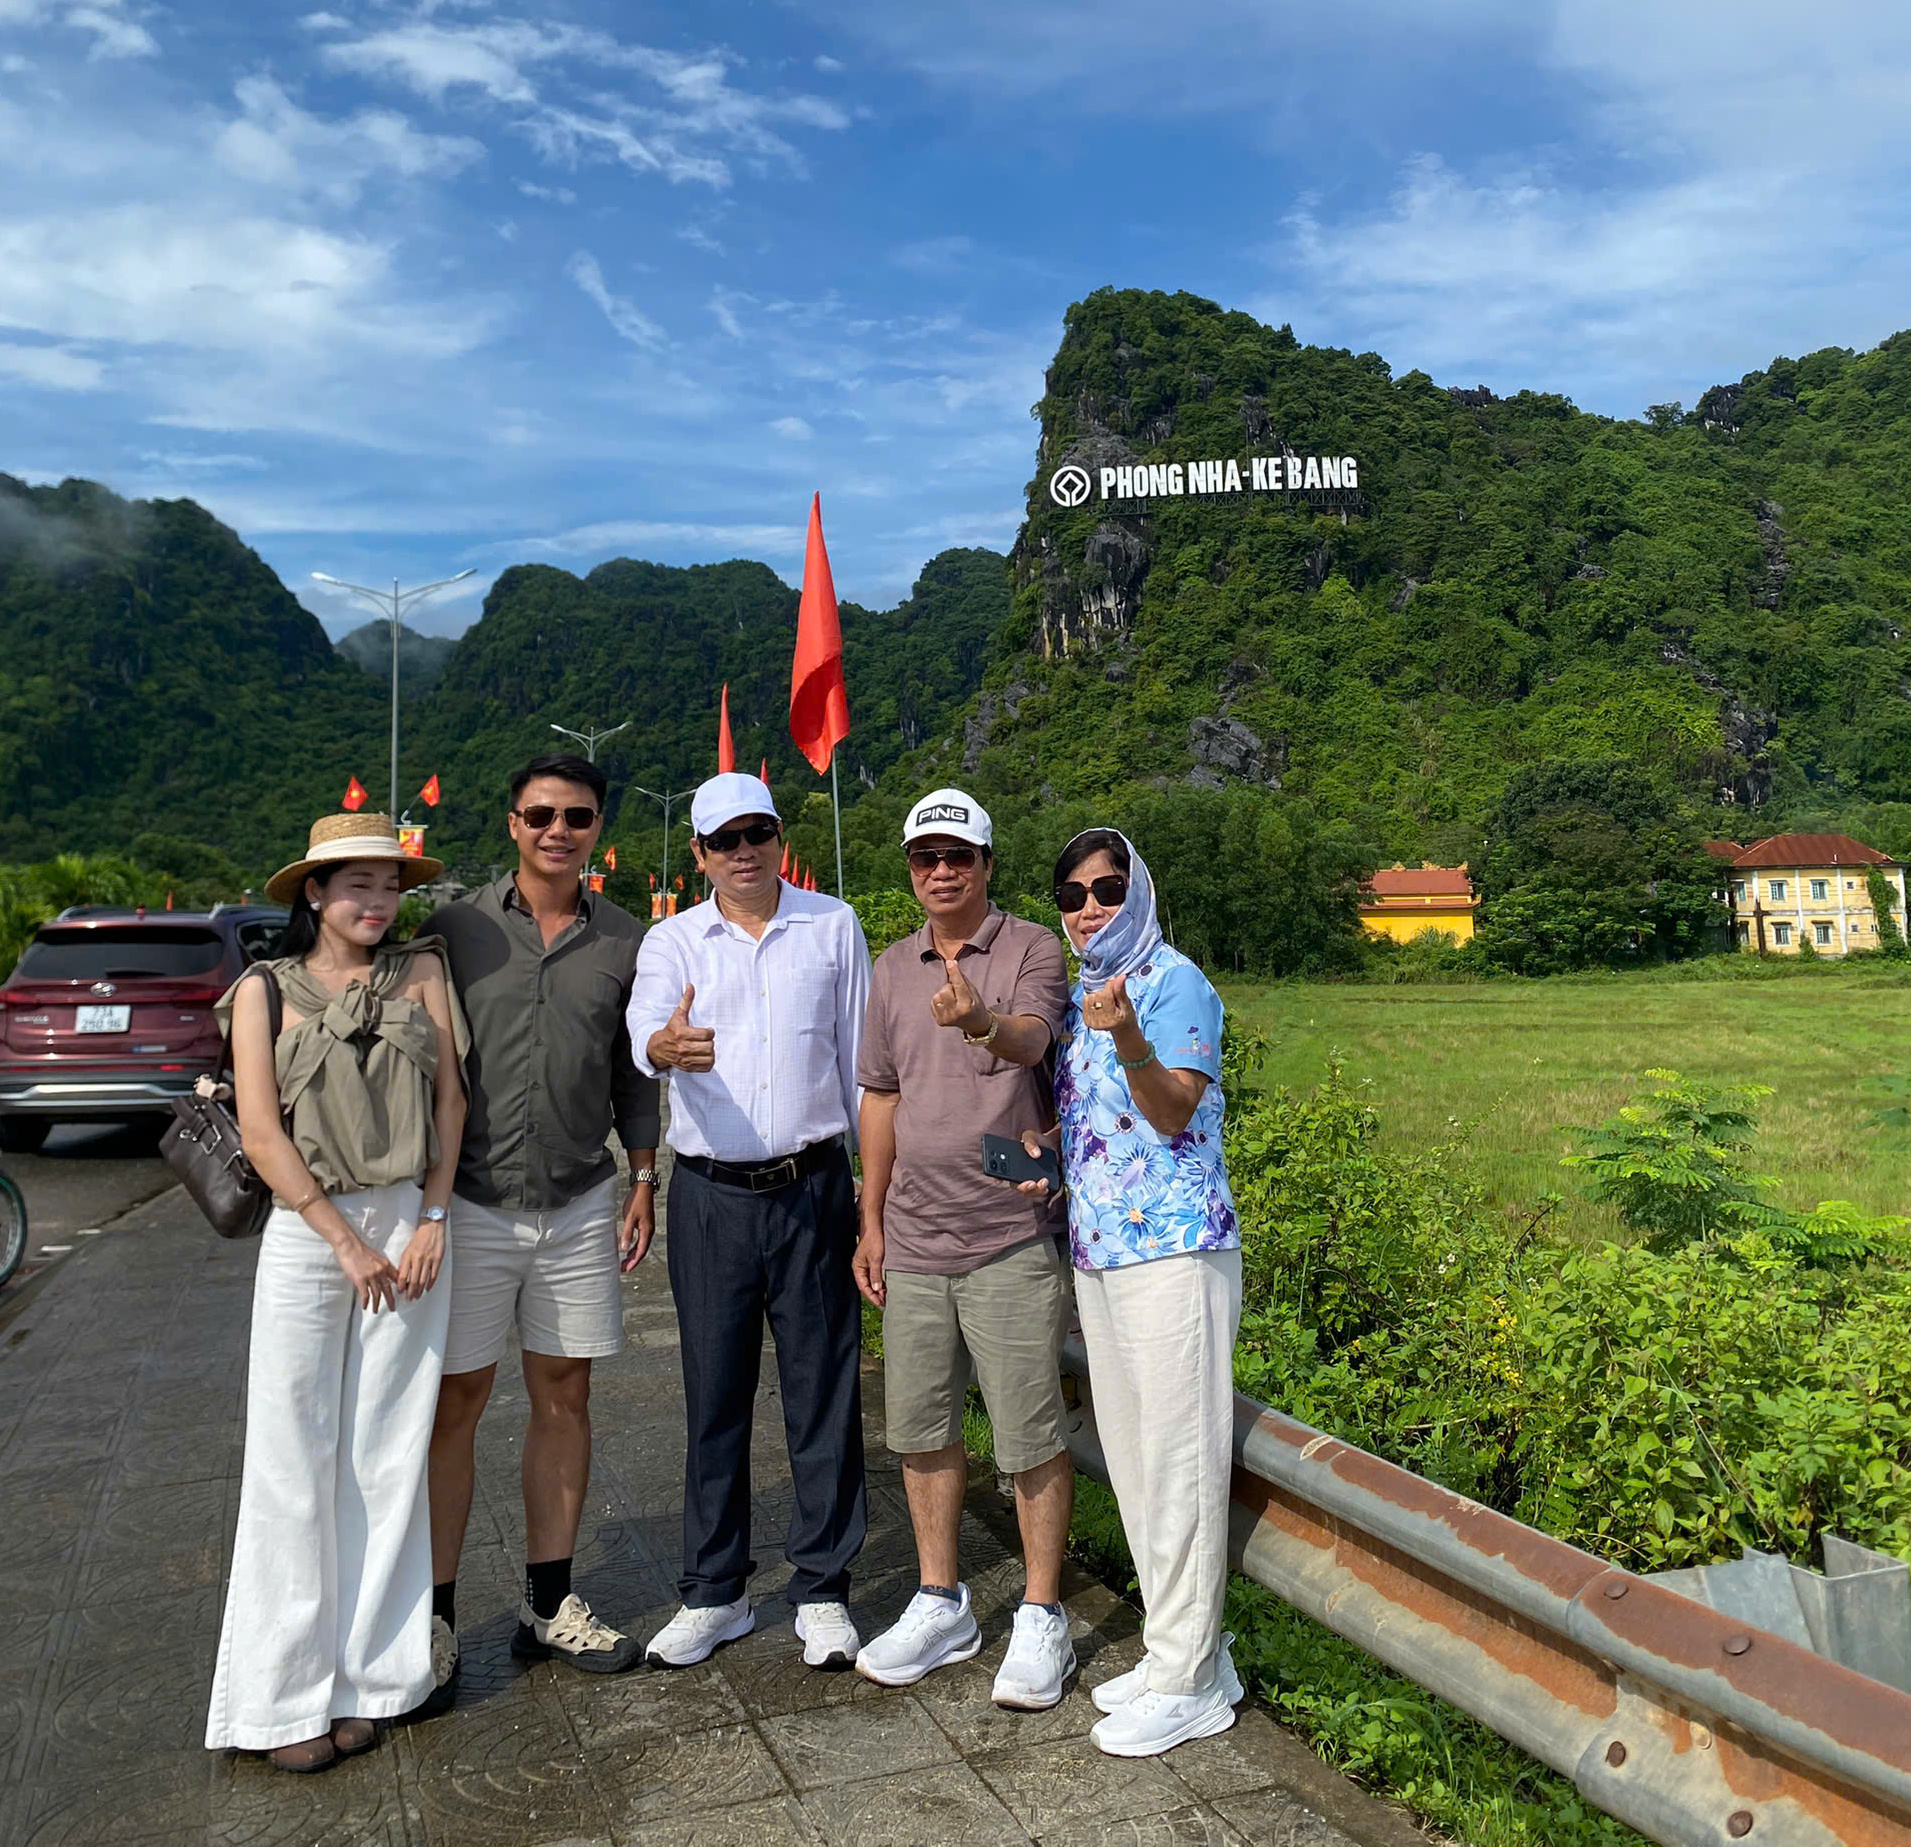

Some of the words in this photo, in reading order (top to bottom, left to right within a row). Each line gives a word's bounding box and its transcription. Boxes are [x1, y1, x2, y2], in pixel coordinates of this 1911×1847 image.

[1100, 464, 1184, 500] PHONG
[1287, 456, 1359, 489] BANG
[918, 806, 966, 824] PING
